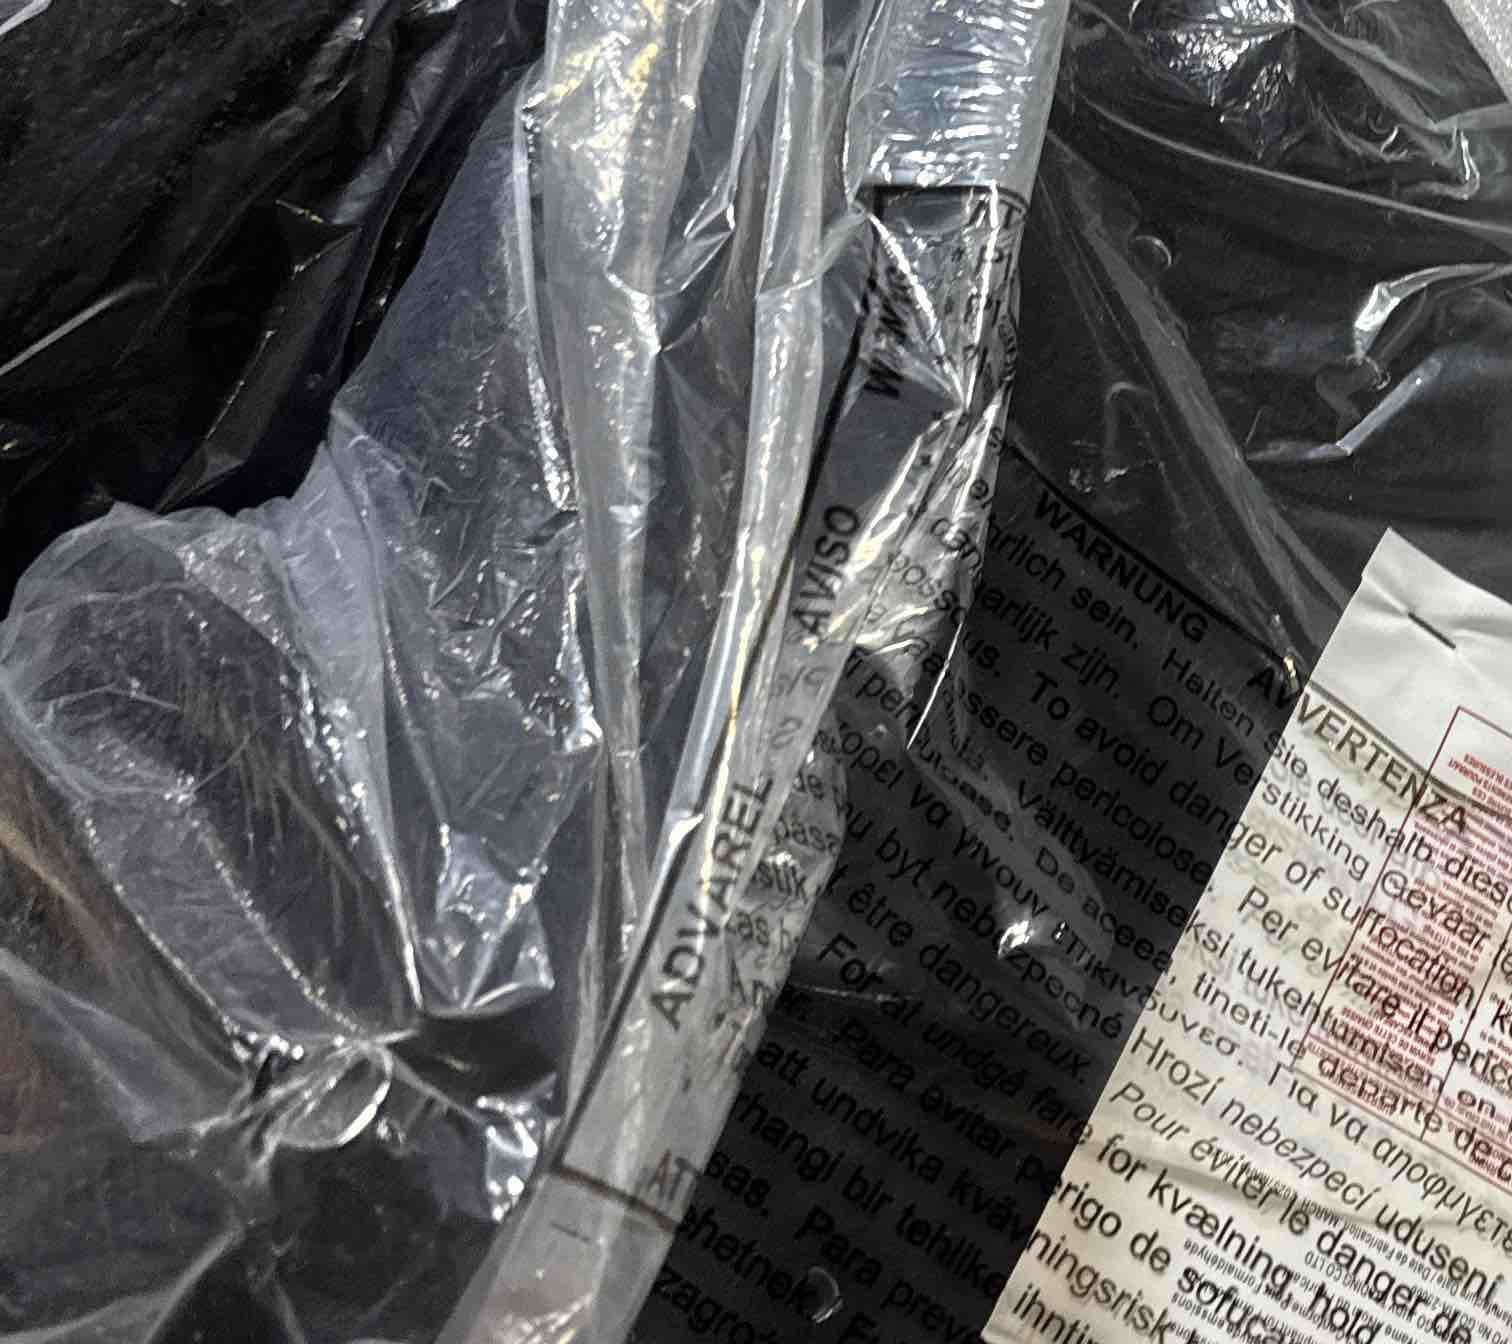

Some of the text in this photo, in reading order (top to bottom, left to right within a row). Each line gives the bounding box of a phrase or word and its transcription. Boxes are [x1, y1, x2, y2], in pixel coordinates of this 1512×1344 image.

[793, 503, 862, 635] AVISO
[1027, 489, 1214, 645] WARNUNG
[1244, 660, 1476, 839] AVVERTENZA
[1020, 668, 1079, 725] To
[1072, 708, 1168, 787] avoid
[1165, 770, 1283, 877] danger
[1282, 851, 1329, 895] of
[1054, 637, 1131, 706] zijn.
[1140, 689, 1211, 752] Om
[1203, 734, 1378, 883] Verstikking
[1375, 864, 1494, 954] Gevaar
[1065, 579, 1151, 652] sein.
[1159, 648, 1261, 738] Halten
[1260, 726, 1314, 783] Sie
[1311, 770, 1438, 866] deshalb
[648, 776, 774, 1032] ADVAREL
[870, 825, 936, 895] byt
[1048, 756, 1226, 893] pericolose.
[1235, 884, 1301, 945] Per
[1296, 931, 1408, 1020] evitare
[753, 1031, 814, 1088] att
[806, 1070, 950, 1187] undvika
[816, 930, 889, 1001] For
[1094, 1130, 1152, 1186] for
[842, 877, 923, 953] être
[1108, 1076, 1194, 1150] Pour
[1186, 1127, 1287, 1217] éviter
[1276, 1197, 1316, 1238] le
[1310, 1223, 1425, 1321] danger
[1029, 844, 1083, 895] De
[1079, 888, 1188, 986] aceea,
[1189, 970, 1312, 1065] tineti-le
[1313, 1047, 1447, 1144] departe
[1449, 1121, 1496, 1167] de
[1231, 944, 1451, 1102] tukehtumisen
[1454, 1081, 1503, 1121] on
[793, 1202, 890, 1290] Para
[838, 1163, 900, 1225] bir
[1124, 1224, 1178, 1274] de
